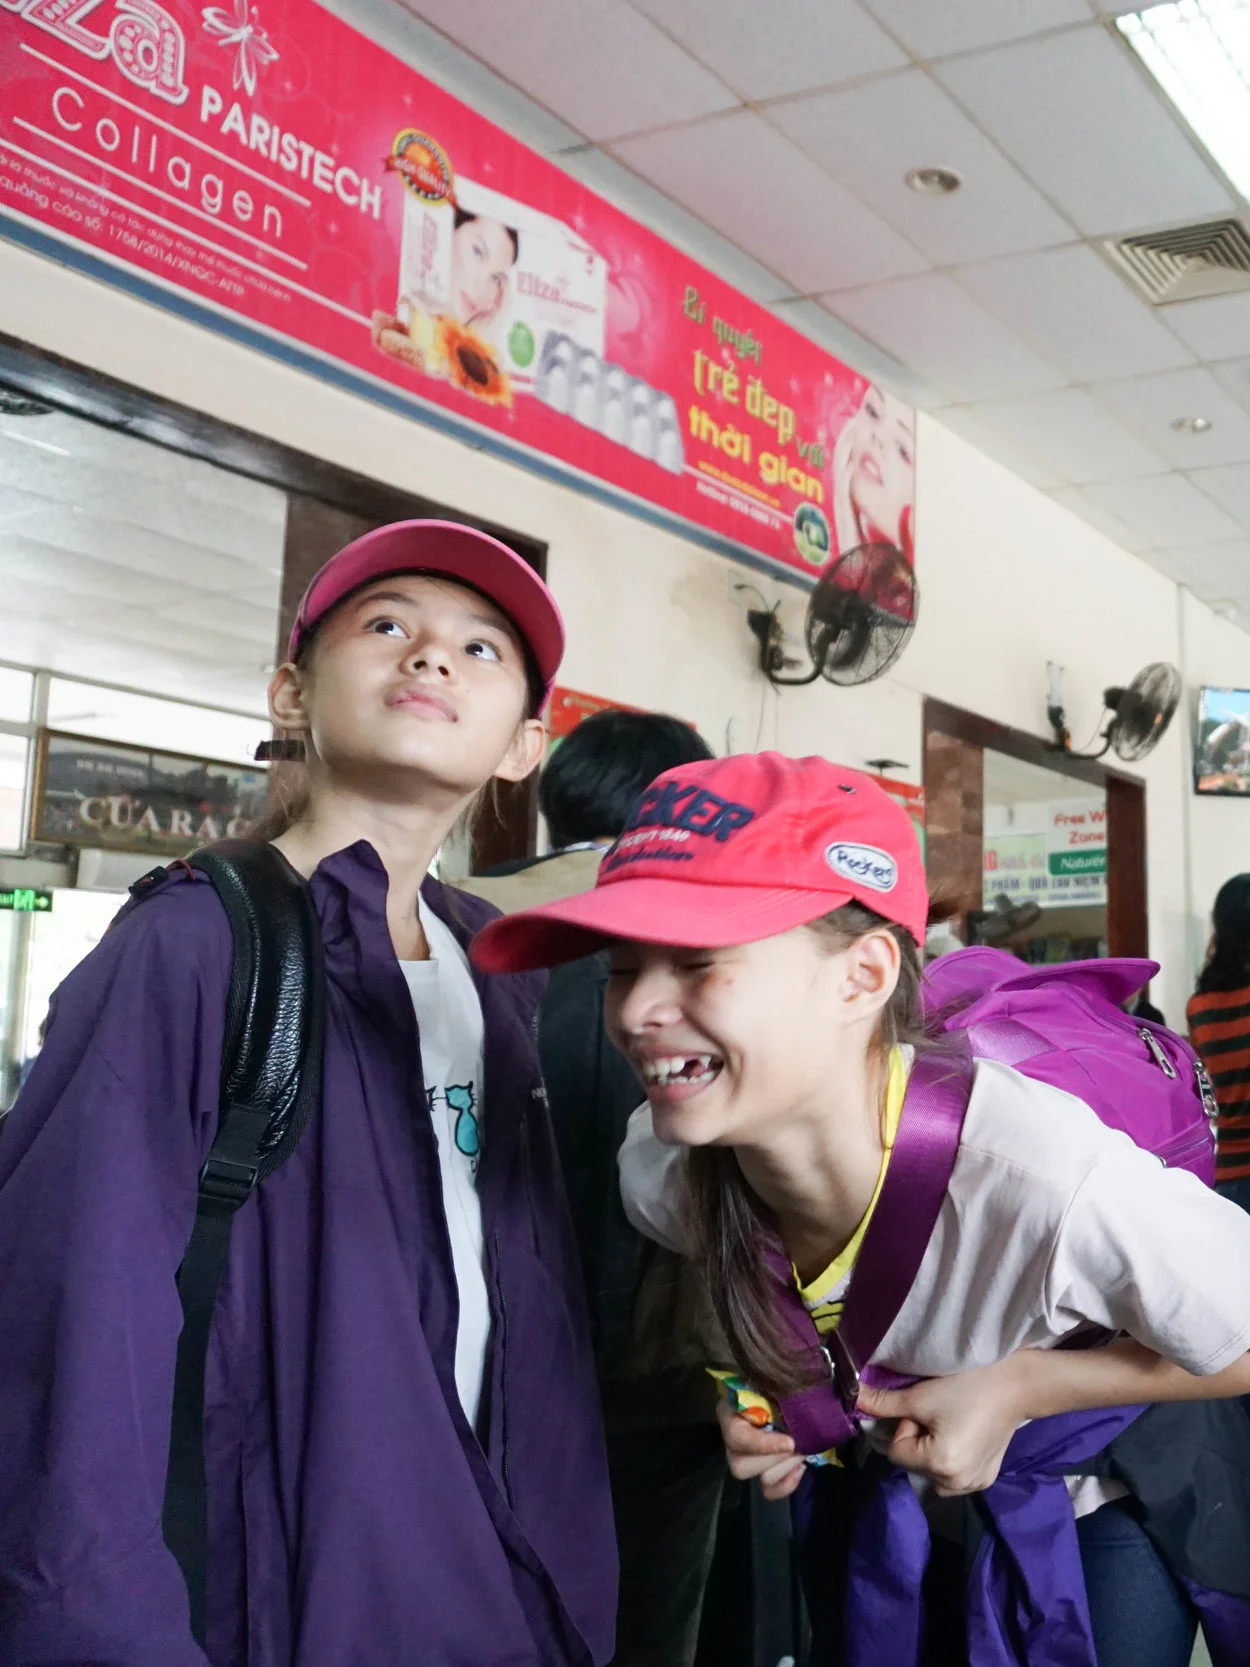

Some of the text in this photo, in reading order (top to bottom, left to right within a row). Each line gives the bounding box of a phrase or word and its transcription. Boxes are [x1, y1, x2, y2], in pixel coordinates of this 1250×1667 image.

[52, 87, 283, 238] Collagen
[200, 84, 382, 219] PARISTECH
[758, 451, 824, 507] gian
[1054, 812, 1085, 826] Free
[1068, 831, 1105, 845] Zone
